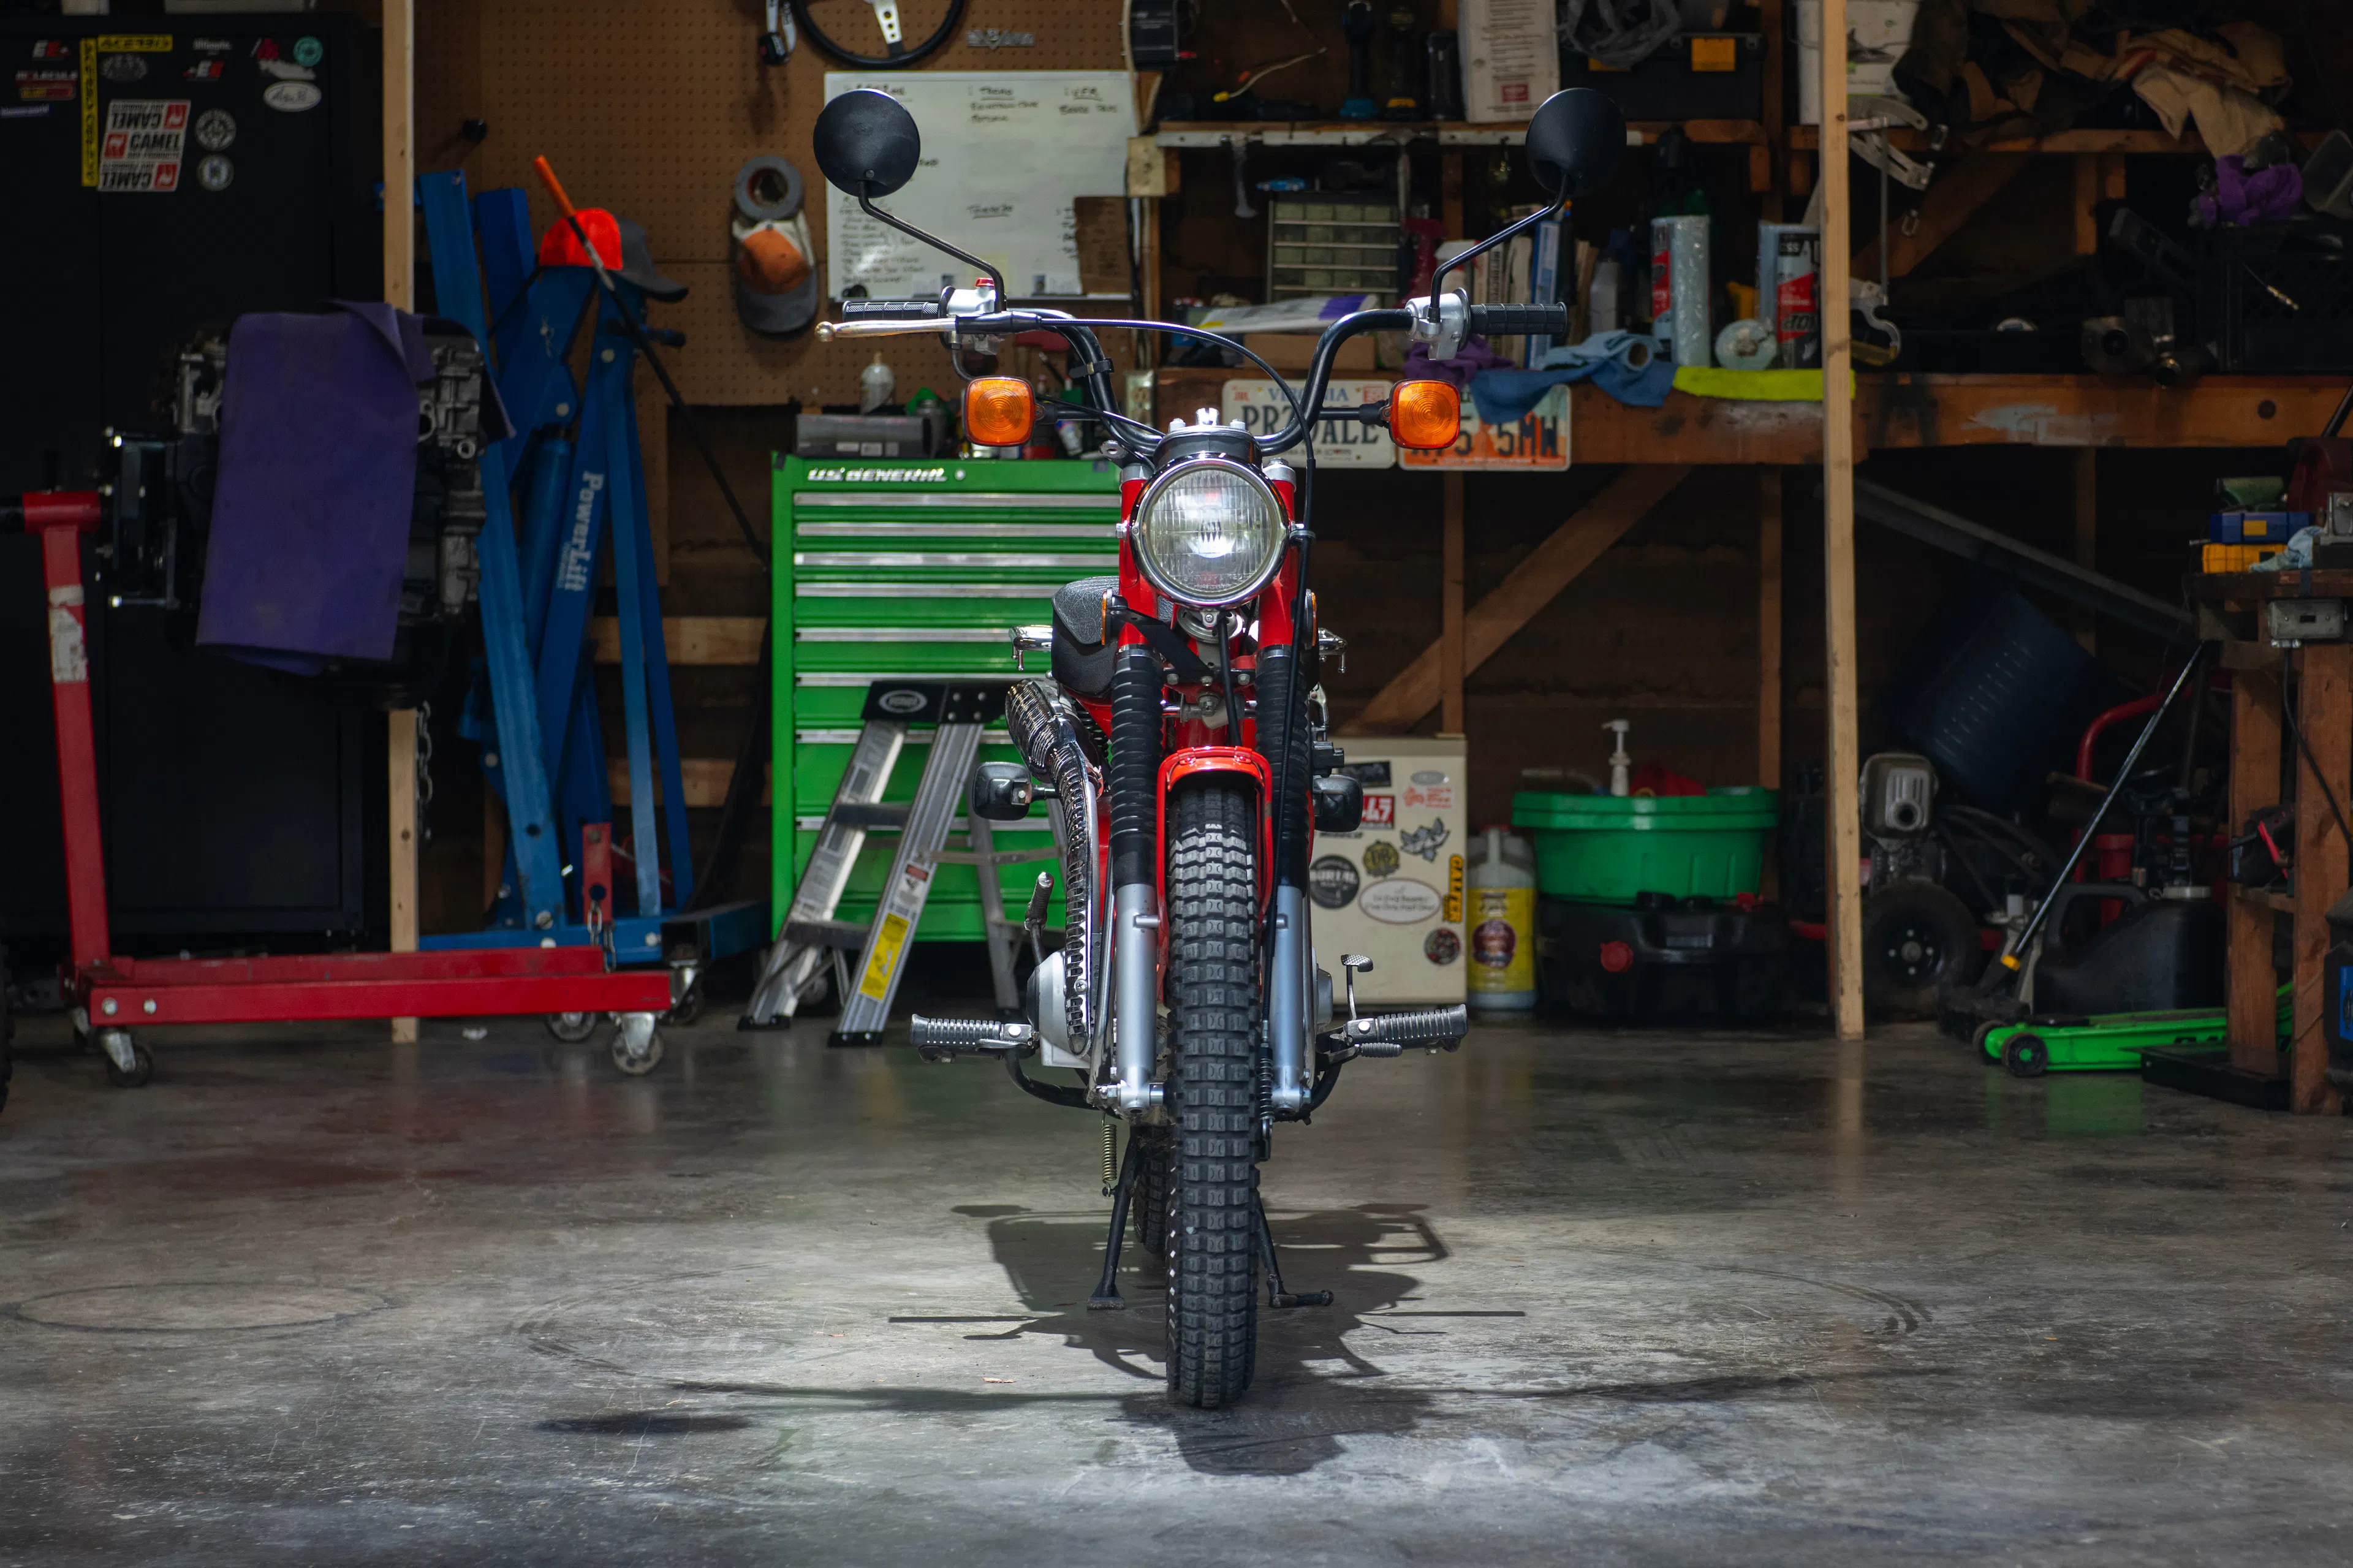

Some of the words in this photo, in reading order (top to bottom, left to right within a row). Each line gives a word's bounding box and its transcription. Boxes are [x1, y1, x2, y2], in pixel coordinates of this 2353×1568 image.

[112, 113, 161, 129] CAMEL
[129, 132, 180, 150] CAMEL
[102, 172, 152, 186] CAMEL
[1268, 387, 1349, 401] VIRIA
[1241, 404, 1379, 444] PRALE
[846, 468, 947, 482] GENERAL
[564, 471, 604, 592] PowerLift
